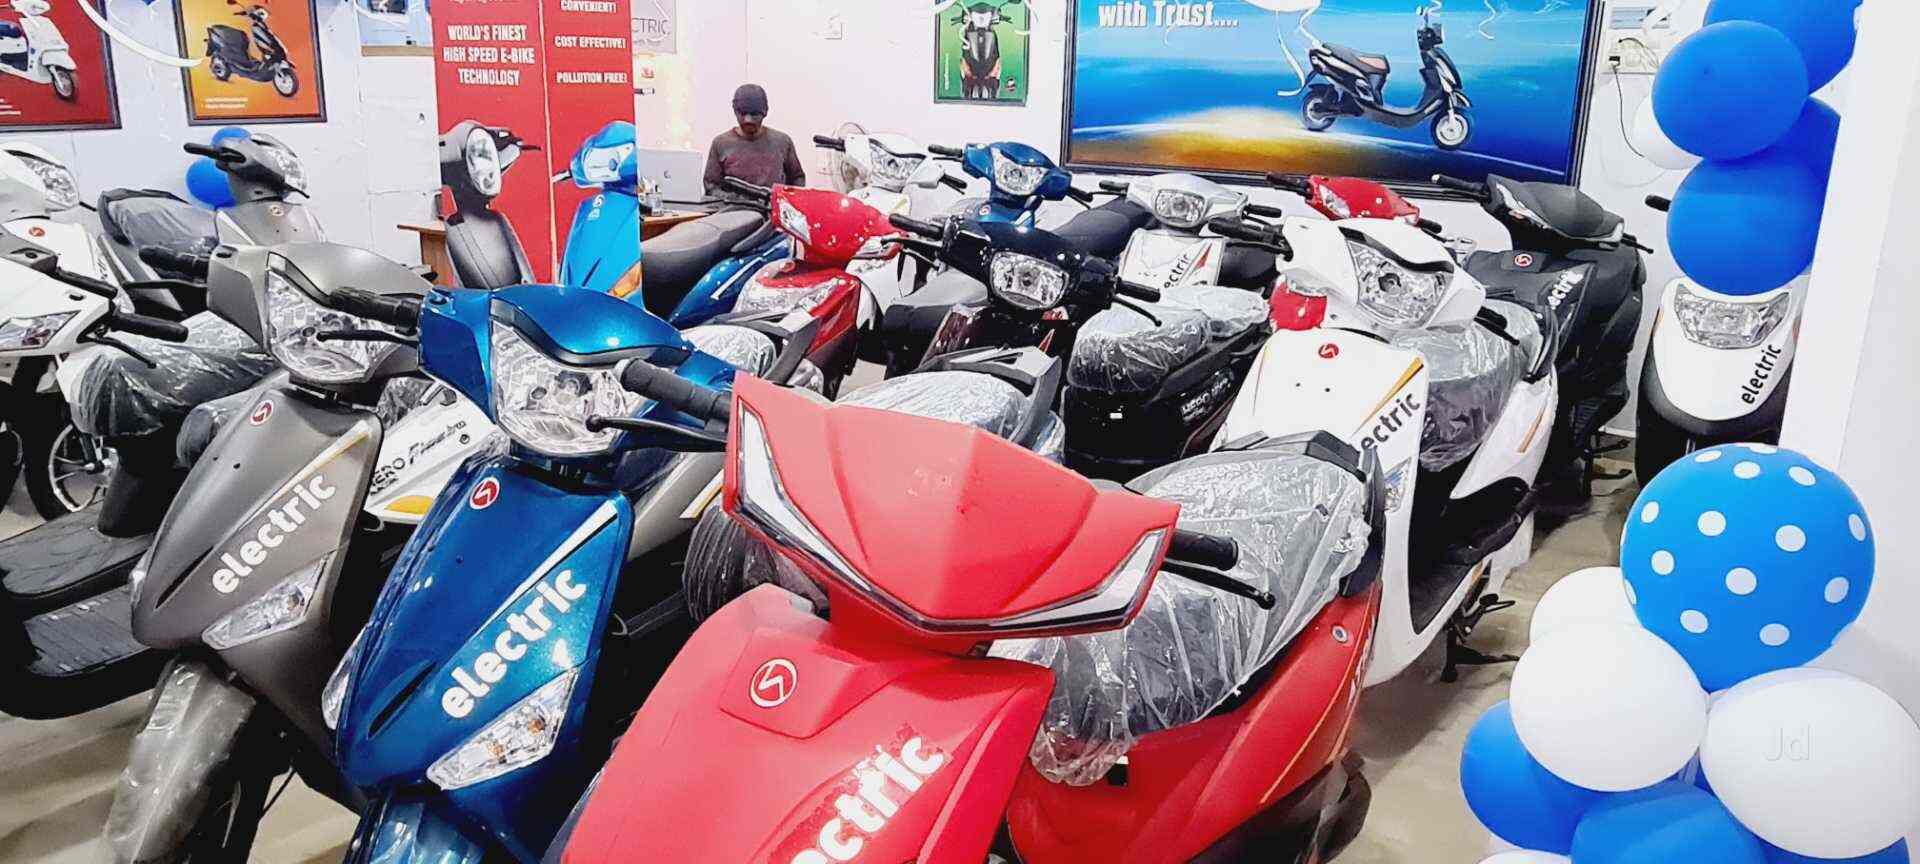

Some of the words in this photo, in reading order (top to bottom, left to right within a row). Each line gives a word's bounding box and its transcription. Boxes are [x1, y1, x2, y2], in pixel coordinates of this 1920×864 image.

[1098, 0, 1148, 27] with
[447, 24, 490, 41] WORLD'S
[492, 24, 528, 41] FINEST
[554, 36, 578, 48] COST
[579, 37, 626, 49] EFFECTIVE!
[443, 46, 466, 62] HIGH
[468, 47, 499, 63] SPEED
[500, 47, 536, 64] E-BIKE
[458, 68, 520, 86] TECHNOLOGY
[556, 72, 603, 83] POLLUTION
[1741, 344, 1782, 404] electric
[212, 474, 336, 594] electric
[441, 569, 587, 718] electric
